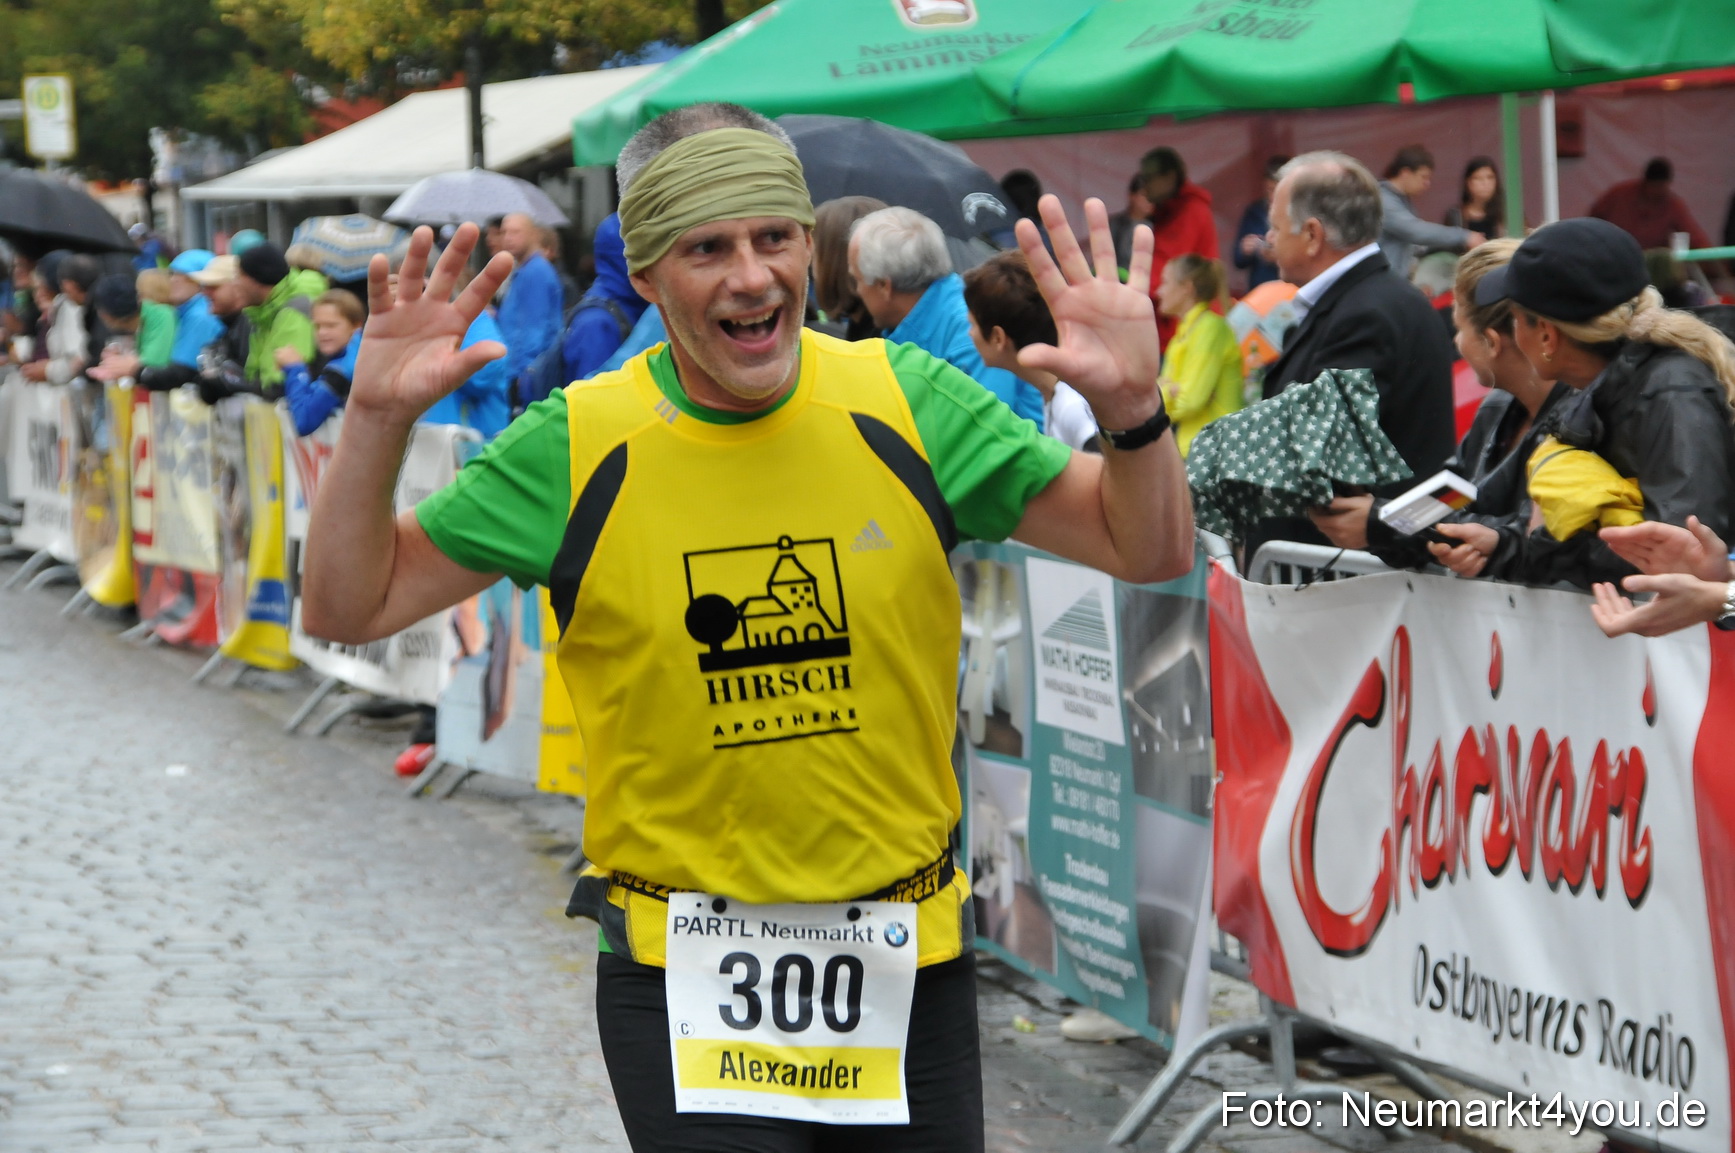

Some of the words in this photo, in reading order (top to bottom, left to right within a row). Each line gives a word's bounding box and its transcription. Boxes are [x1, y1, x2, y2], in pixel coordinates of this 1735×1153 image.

[1124, 8, 1314, 49] Lsbräu
[705, 664, 852, 705] HIRSCH
[714, 707, 857, 737] APOTHEKE
[1290, 625, 1658, 957] Charivari
[880, 870, 940, 902] ueezy
[673, 916, 753, 938] PARTL
[761, 921, 874, 943] Neumarkt
[719, 952, 864, 1033] 300
[680, 1022, 690, 1036] C
[1414, 944, 1588, 1057] Ostbayerns
[1597, 997, 1697, 1092] Radio
[719, 1051, 862, 1090] Alexander
